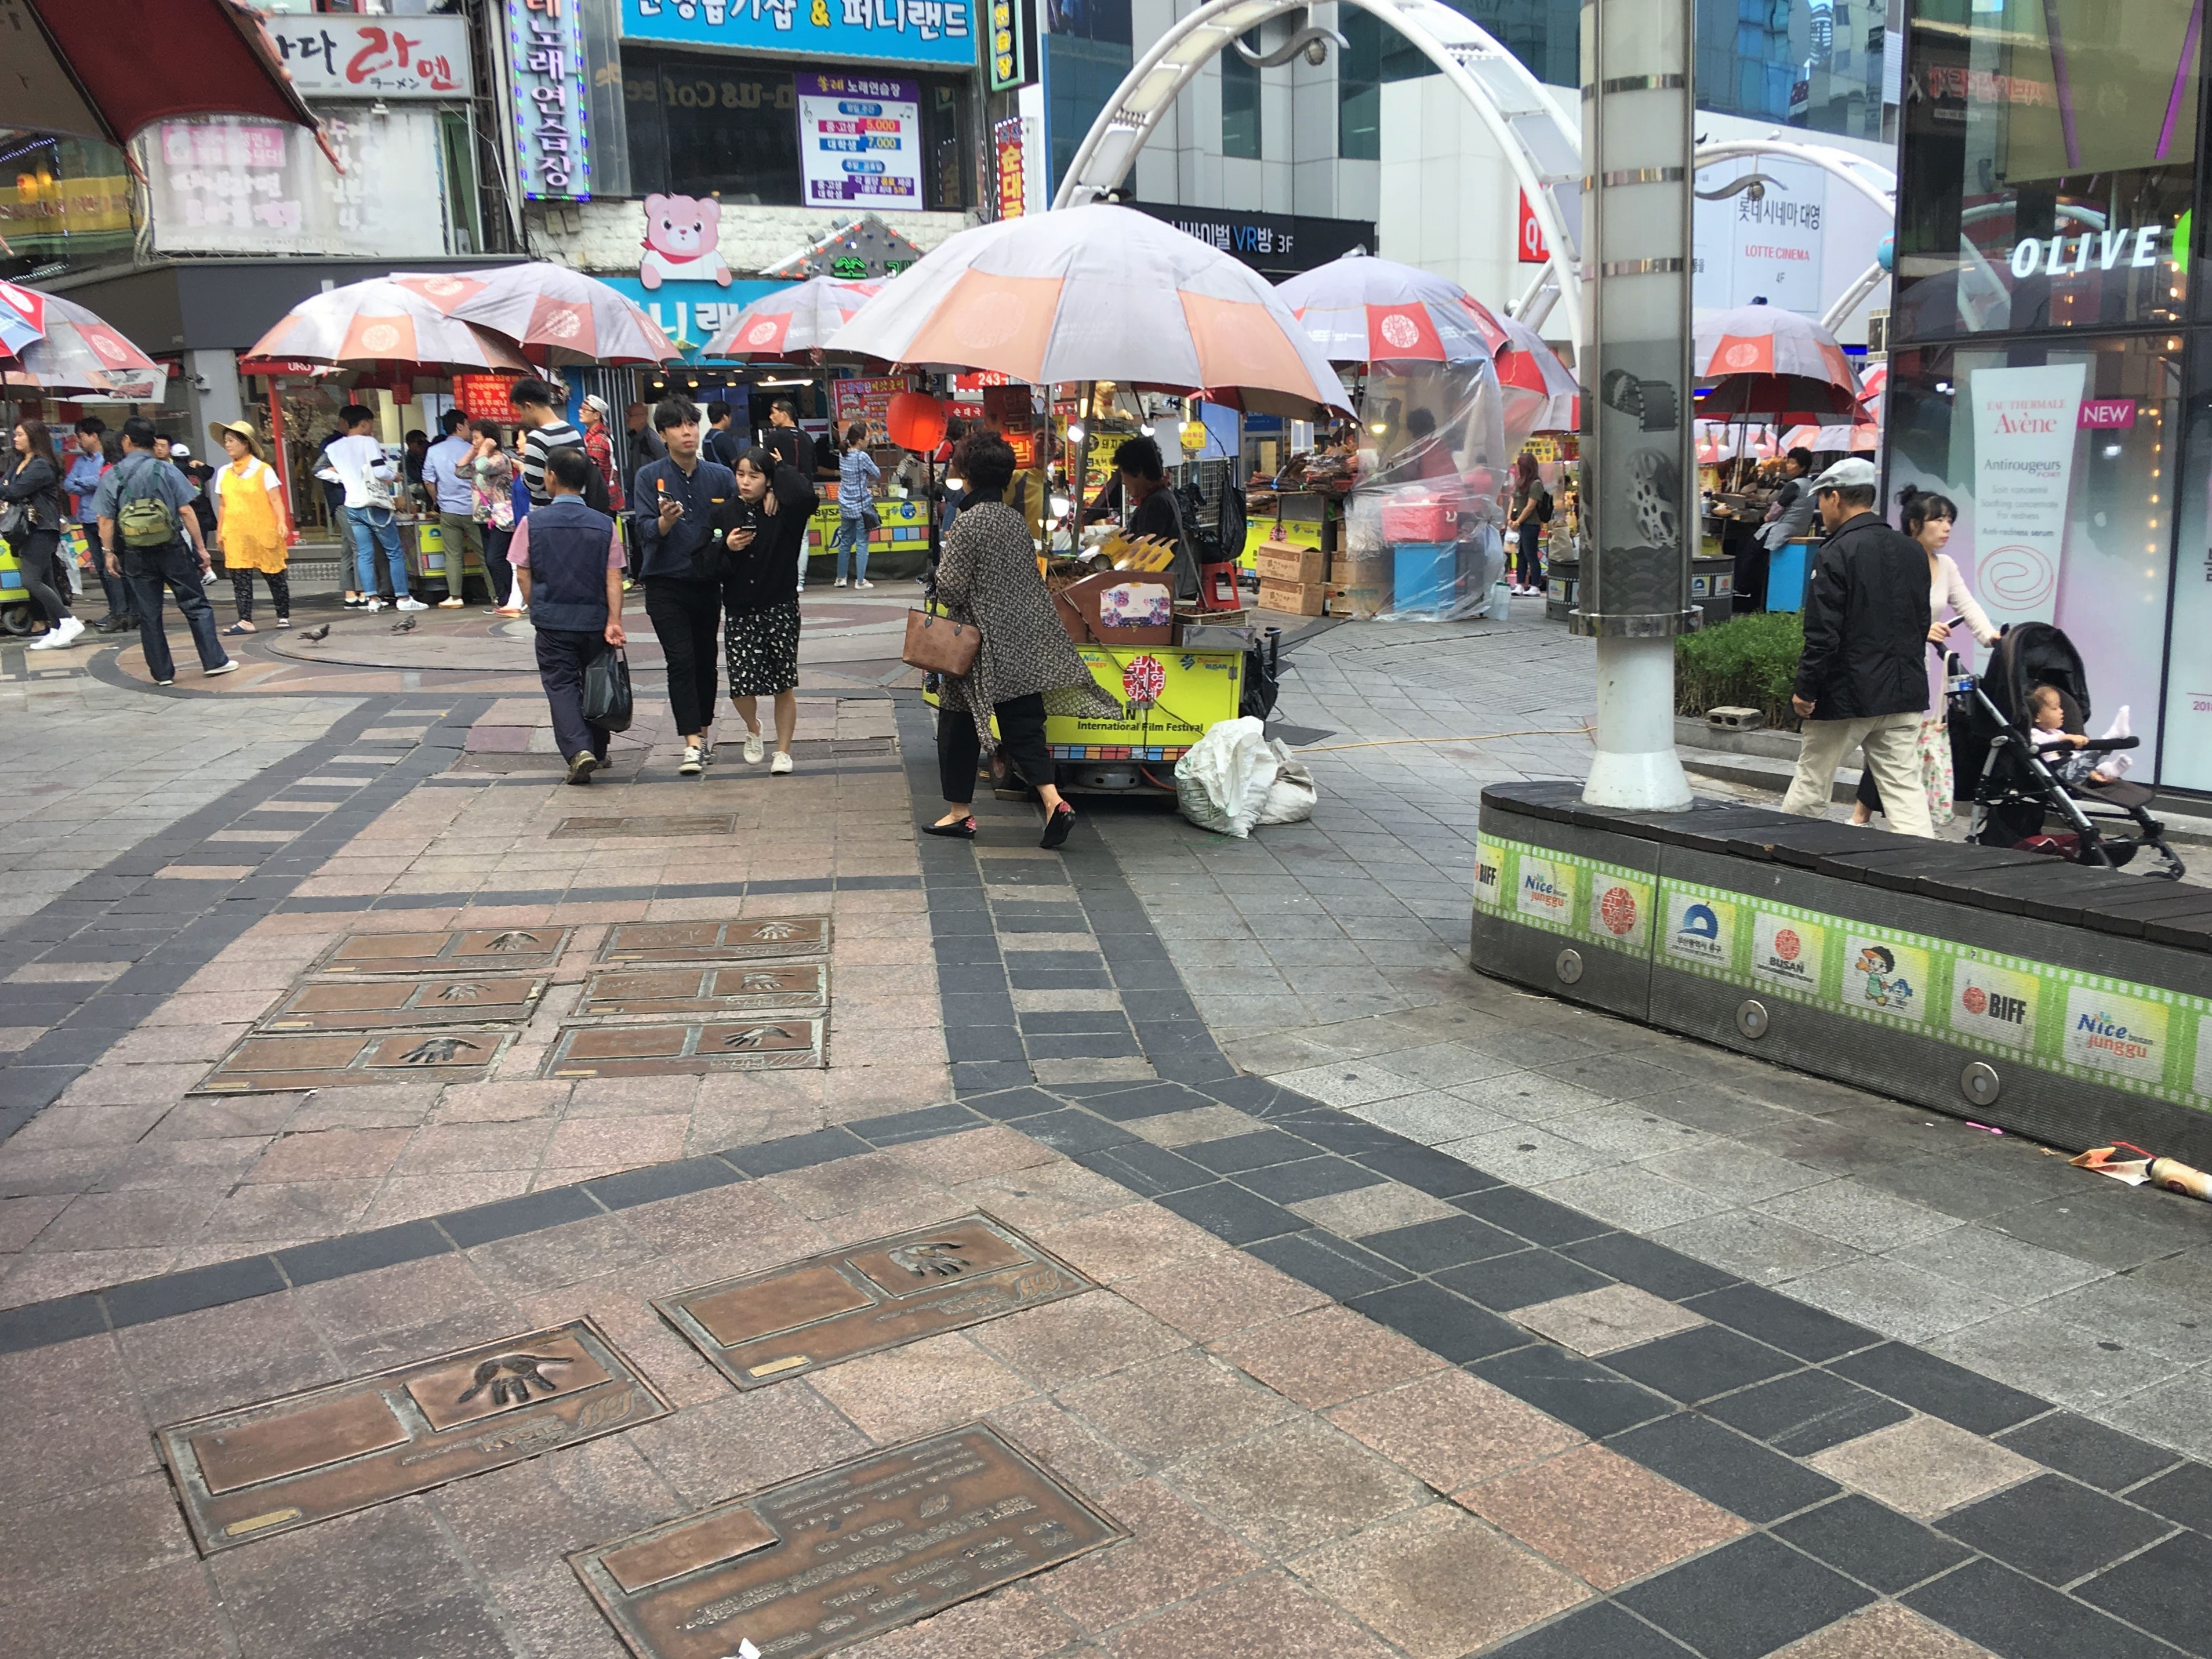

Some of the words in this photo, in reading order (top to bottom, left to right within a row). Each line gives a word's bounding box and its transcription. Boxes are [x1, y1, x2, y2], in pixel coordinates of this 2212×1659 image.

[638, 0, 797, 31] 뽑기샵
[847, 79, 900, 97] 노래연습장
[526, 20, 575, 187] 노래연습장
[1233, 225, 1273, 253] VR방
[1277, 234, 1294, 253] 3F
[1745, 244, 1774, 259] LOTTE
[1775, 246, 1810, 261] CINEMA
[2011, 224, 2163, 278] OLIVE
[2010, 398, 2065, 411] THERMALE
[2083, 405, 2130, 423] NEW
[1994, 412, 2058, 434] Avène
[1984, 458, 2061, 474] Antirougeurs
[1077, 721, 1139, 731] International
[1141, 721, 1164, 731] Film
[1165, 723, 1204, 732] Festival
[1479, 863, 1497, 886] BIFF
[1524, 873, 1553, 894] Nice
[1530, 891, 1564, 907] junggu
[1769, 957, 1805, 974] BUSAN
[1988, 992, 2027, 1025] BIFF
[2077, 1014, 2127, 1039] Nice
[2087, 1034, 2147, 1059] junggu
[988, 1499, 1038, 1522] There
